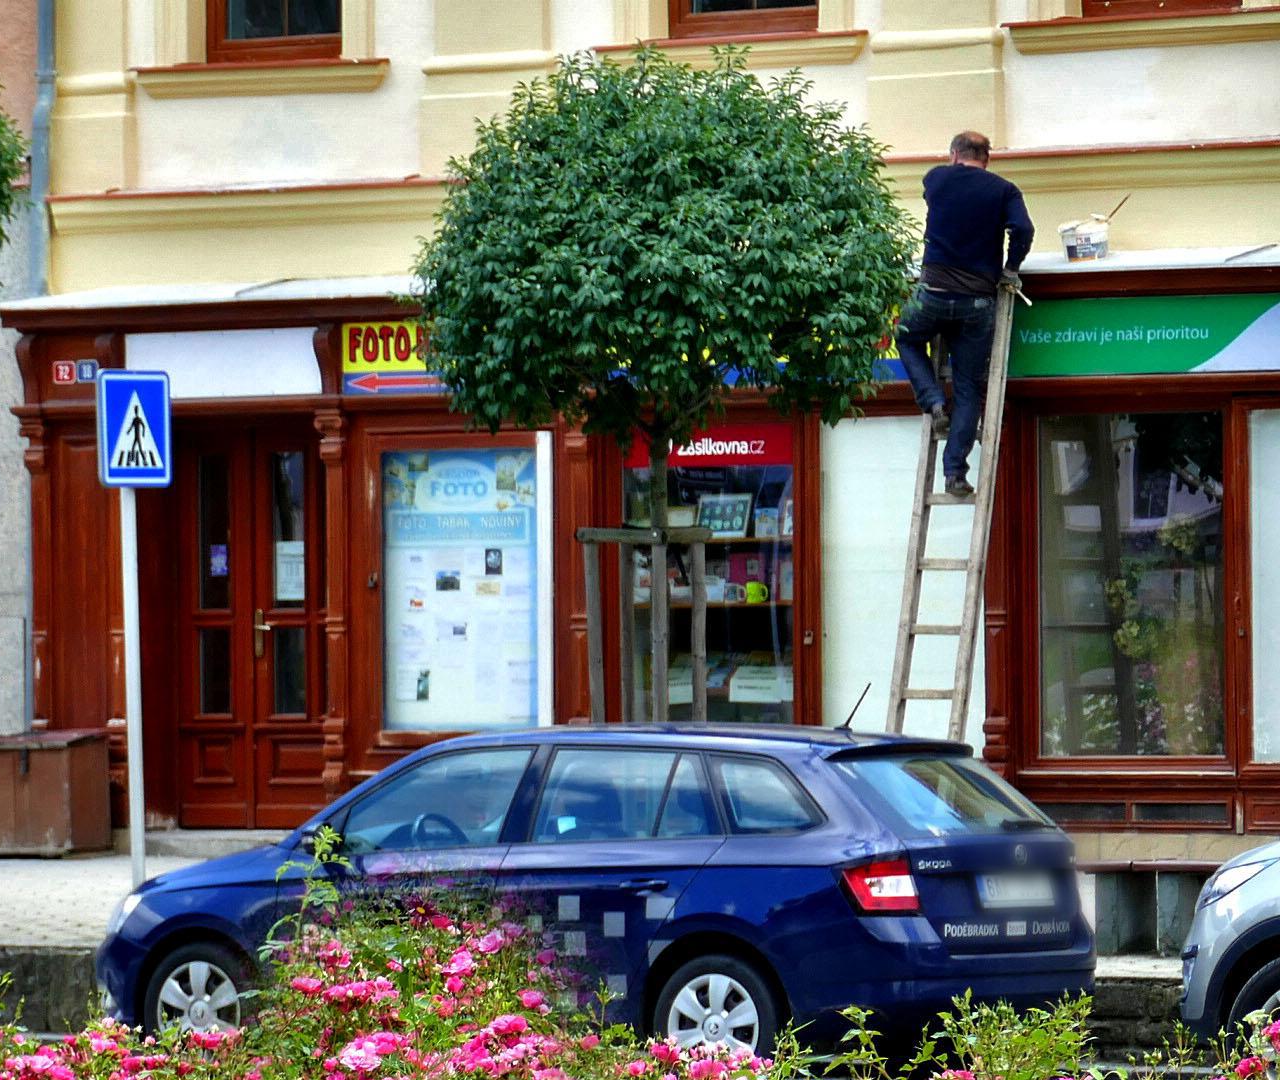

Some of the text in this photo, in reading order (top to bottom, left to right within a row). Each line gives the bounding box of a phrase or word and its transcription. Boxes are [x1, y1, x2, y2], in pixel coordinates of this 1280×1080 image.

[349, 325, 412, 363] FOTO
[1020, 328, 1052, 344] Vaše
[1099, 326, 1113, 346] je
[1147, 324, 1209, 343] prioritou
[430, 481, 489, 498] FOTO
[480, 513, 522, 530] NOVINY
